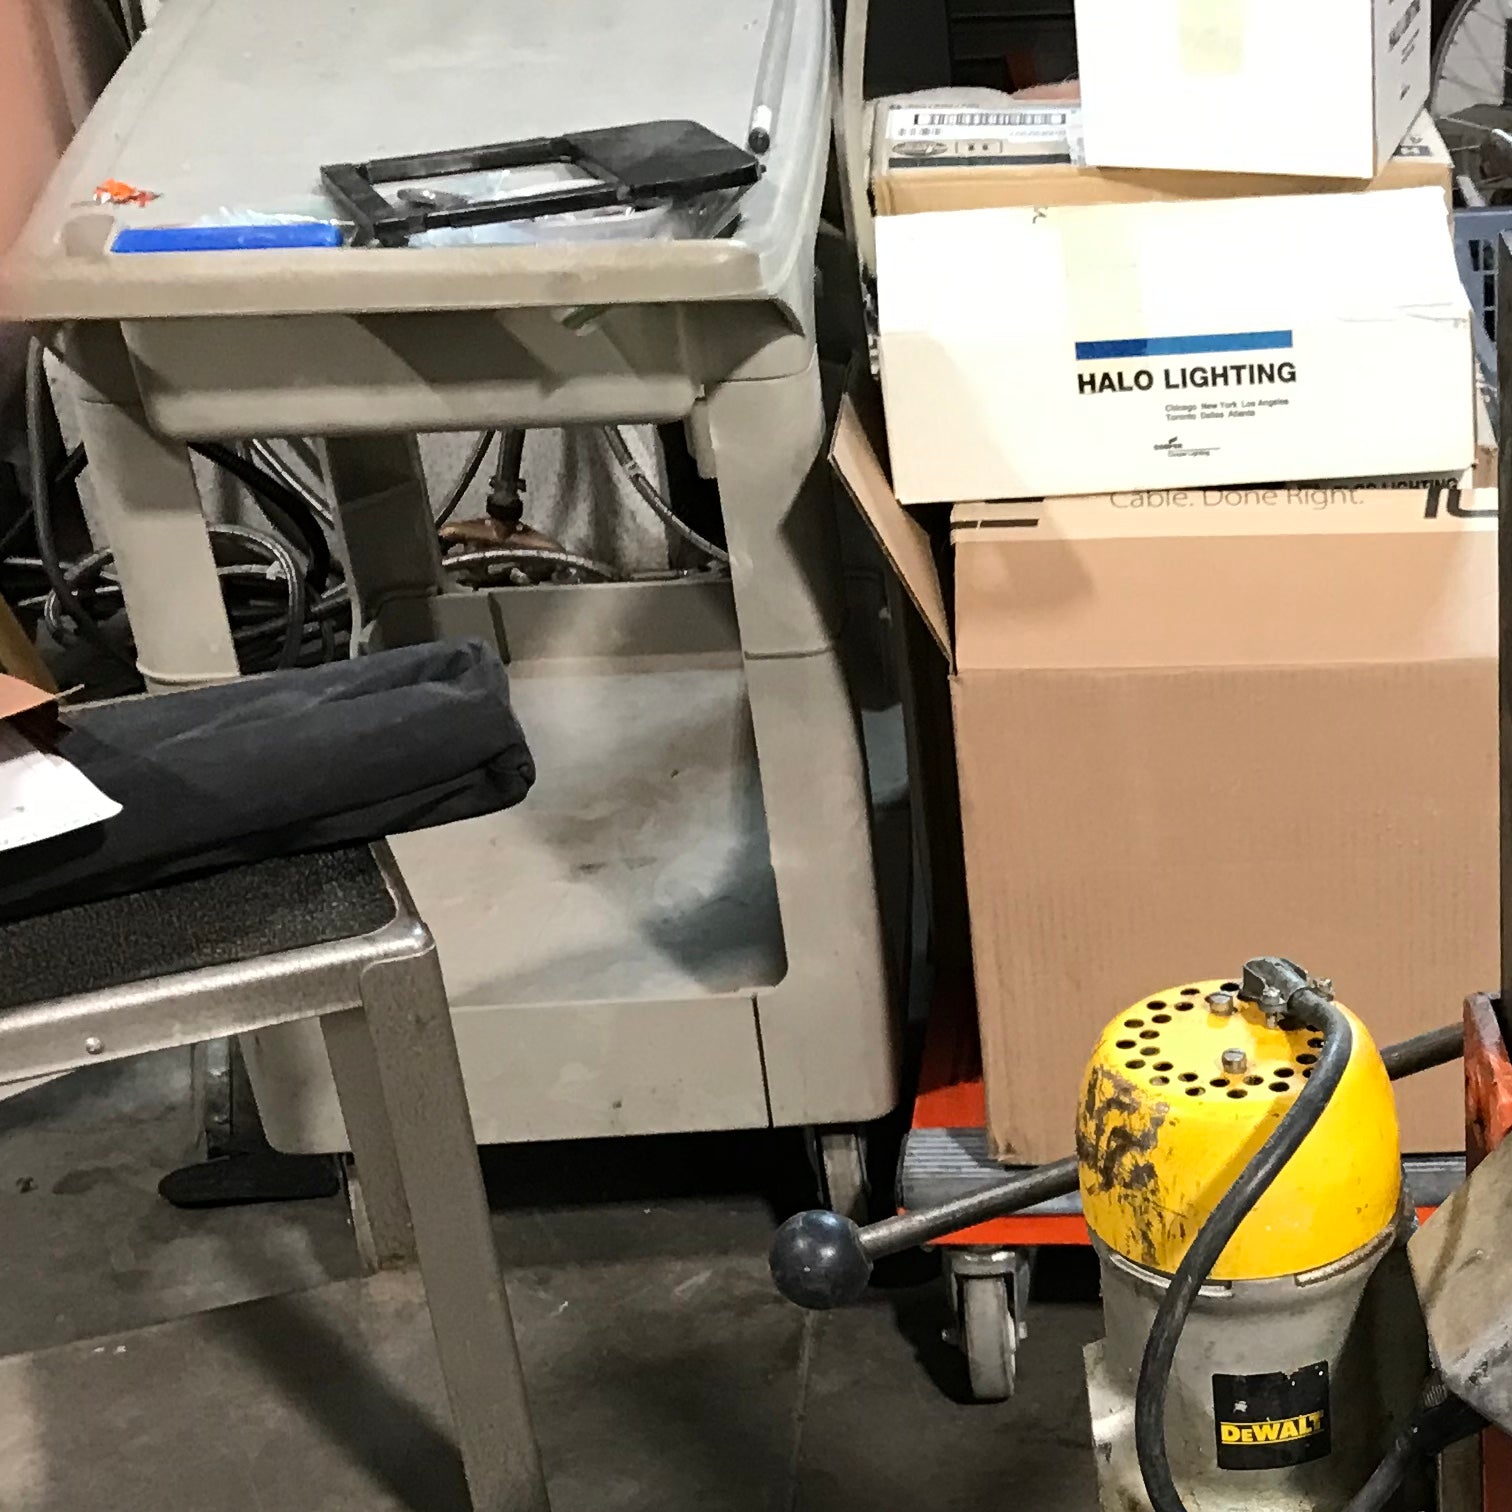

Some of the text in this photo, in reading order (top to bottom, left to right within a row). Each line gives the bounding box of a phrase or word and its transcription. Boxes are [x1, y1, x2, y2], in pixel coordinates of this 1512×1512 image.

[1077, 362, 1297, 394] HALO LIGHTING
[1165, 404, 1197, 413] Chicago
[1258, 398, 1289, 407] Angeles
[1110, 490, 1194, 508] Cable.
[1203, 490, 1278, 506] Done
